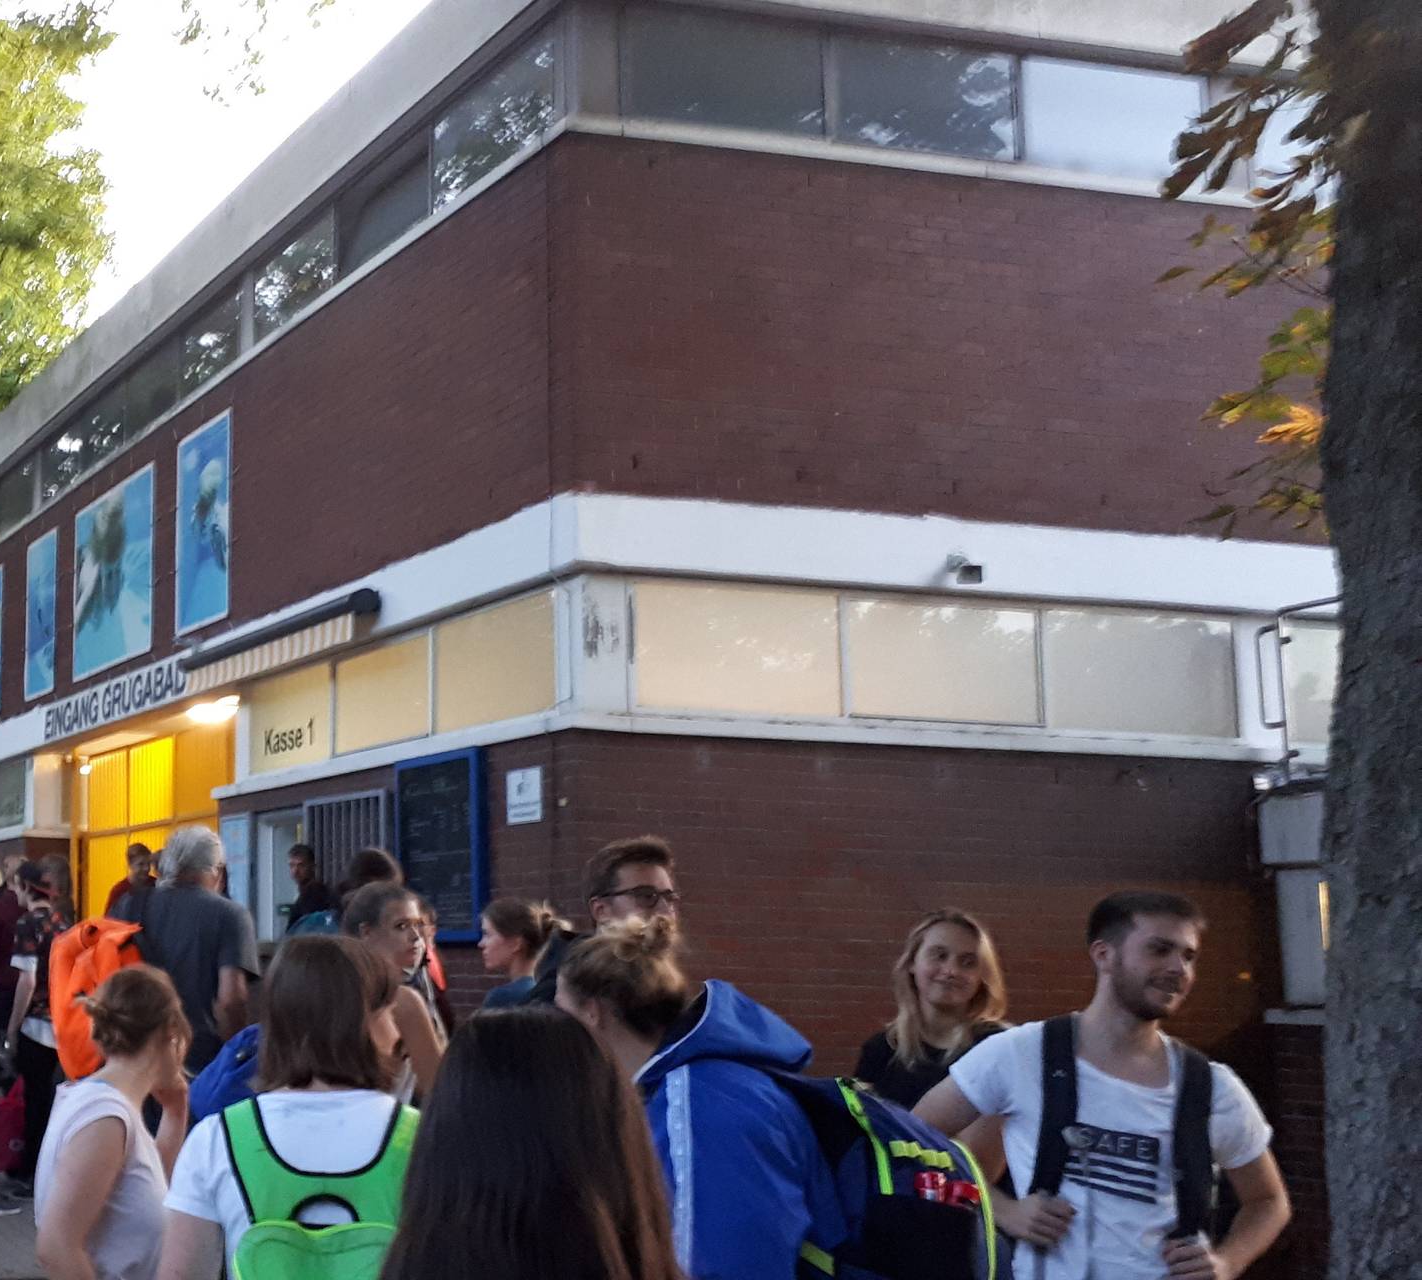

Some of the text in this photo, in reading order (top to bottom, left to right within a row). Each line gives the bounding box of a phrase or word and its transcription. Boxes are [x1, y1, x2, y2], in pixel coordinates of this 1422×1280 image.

[44, 658, 186, 741] EINGANG GRUGABAD
[264, 717, 314, 757] Kasse 1
